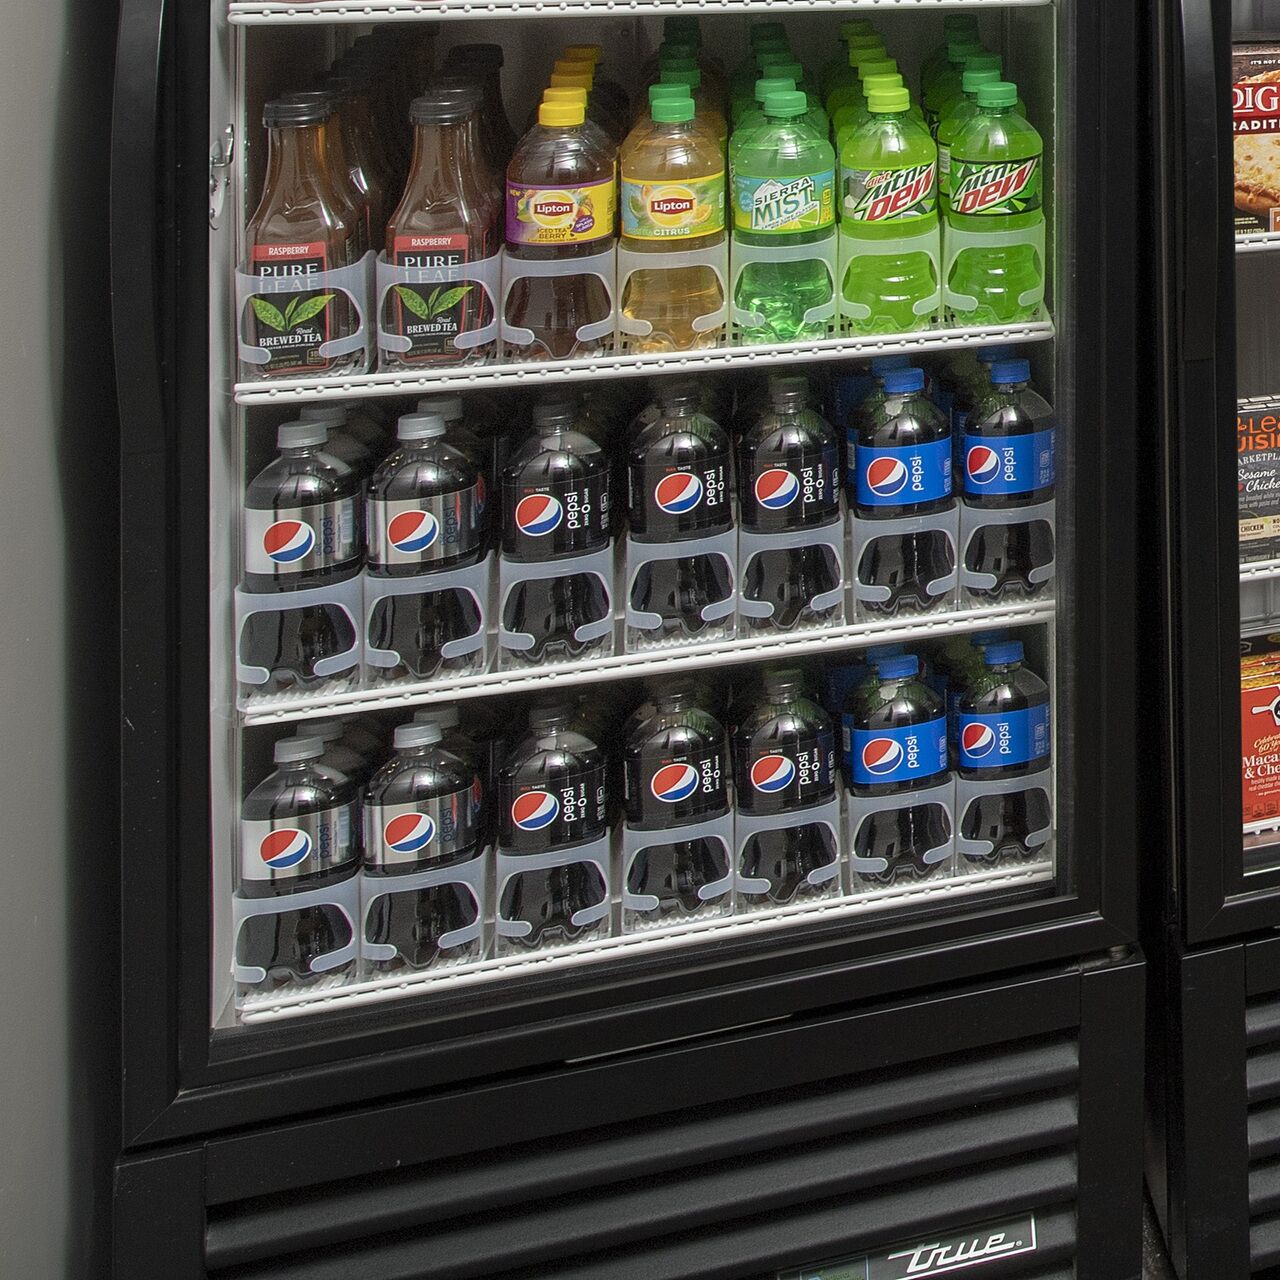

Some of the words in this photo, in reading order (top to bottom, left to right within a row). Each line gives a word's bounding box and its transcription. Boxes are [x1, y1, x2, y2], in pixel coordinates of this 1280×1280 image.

[653, 201, 690, 212] Lipton
[753, 187, 814, 225] MIST
[754, 176, 811, 206] SIERRA
[536, 203, 570, 214] Lipton
[411, 237, 452, 247] RASPBERRY
[653, 227, 690, 236] CITRUS
[269, 246, 310, 256] RASPBERRY
[404, 255, 459, 270] PURE
[260, 264, 319, 280] PURE
[259, 335, 302, 347] BREWED
[303, 333, 322, 343] TEA
[407, 324, 441, 334] BREWED
[442, 322, 458, 332] TEA
[911, 455, 924, 492] pepsi
[1003, 446, 1017, 482] pepsi
[704, 469, 718, 506] pepsi
[801, 467, 815, 503] pepsi
[564, 492, 581, 529] pepsi
[907, 734, 919, 769] pepsi
[702, 758, 712, 794] pepsi
[799, 752, 811, 786] pepsi
[1244, 770, 1256, 780] &
[563, 786, 576, 823] pepsi
[887, 1233, 1016, 1273] True
